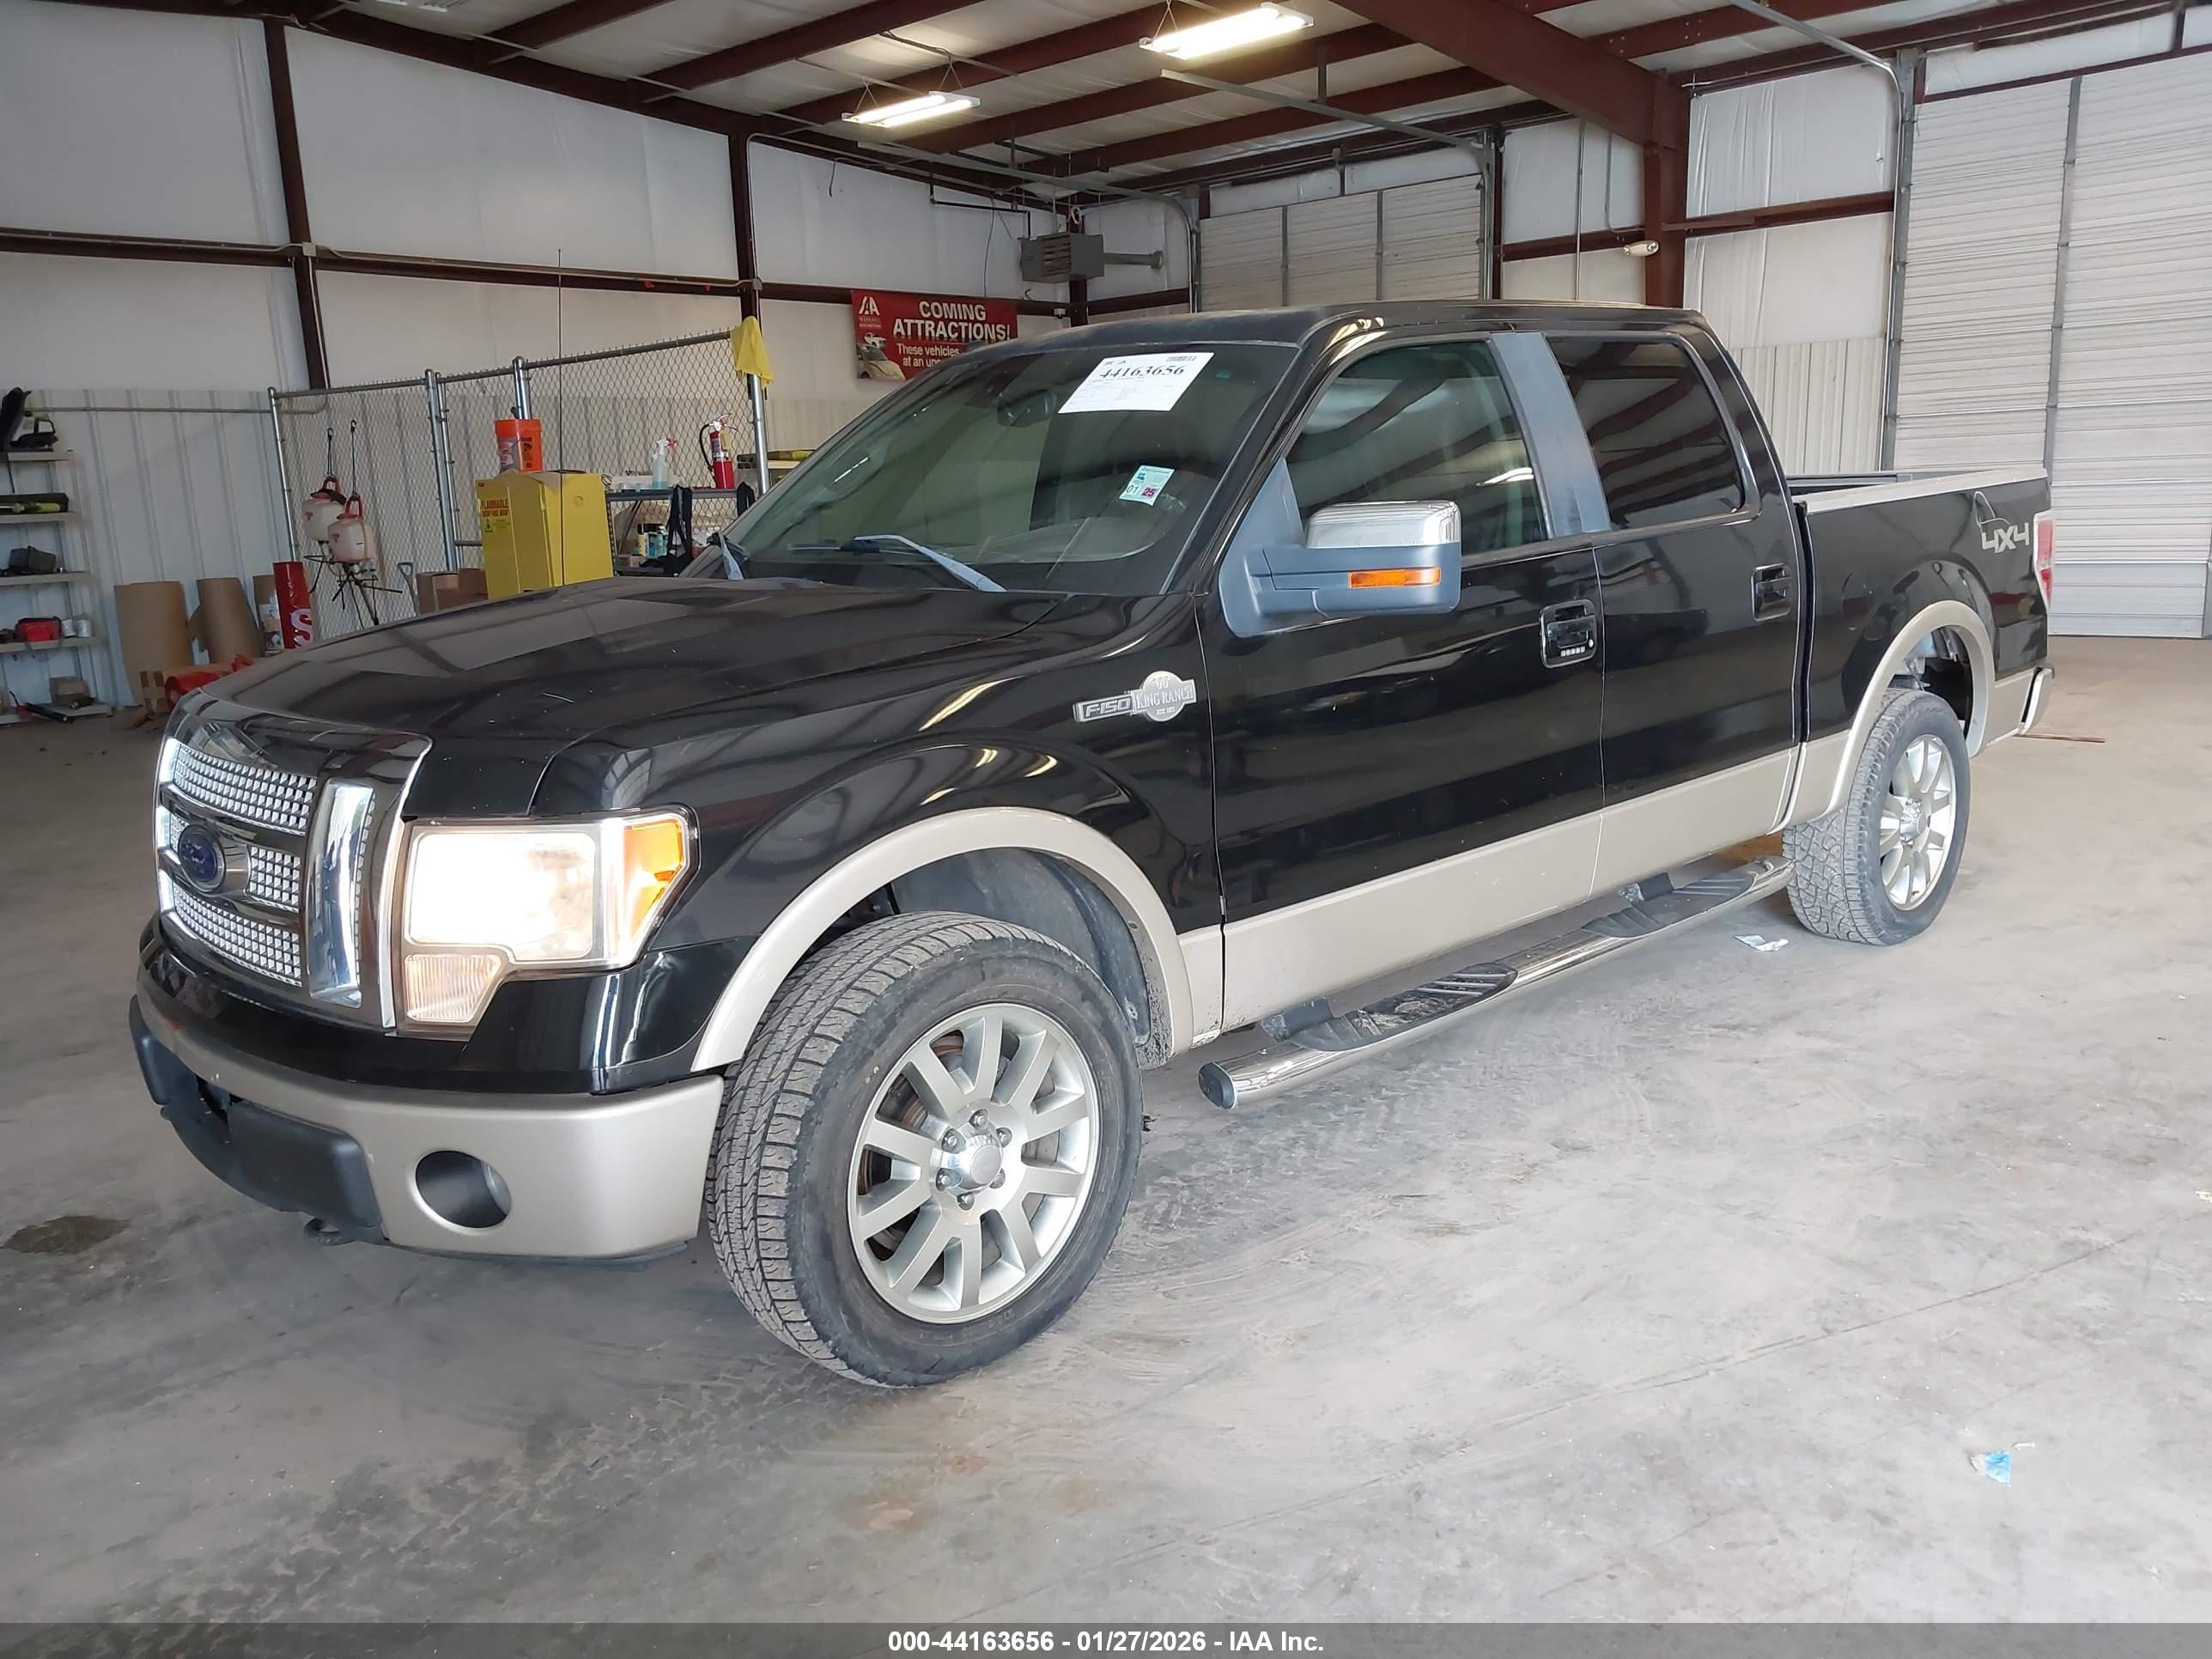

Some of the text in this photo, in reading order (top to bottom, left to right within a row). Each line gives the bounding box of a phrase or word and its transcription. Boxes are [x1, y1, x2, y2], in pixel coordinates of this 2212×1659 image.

[919, 301, 987, 320] COMING
[892, 319, 1011, 341] ATTRACTIONS!
[896, 343, 961, 357] These vehicles
[902, 356, 912, 368] at
[913, 358, 925, 368] an
[1099, 365, 1187, 379] 44163656
[1126, 484, 1157, 497] 01 25
[1085, 684, 1194, 718] F-150 KING RANCH
